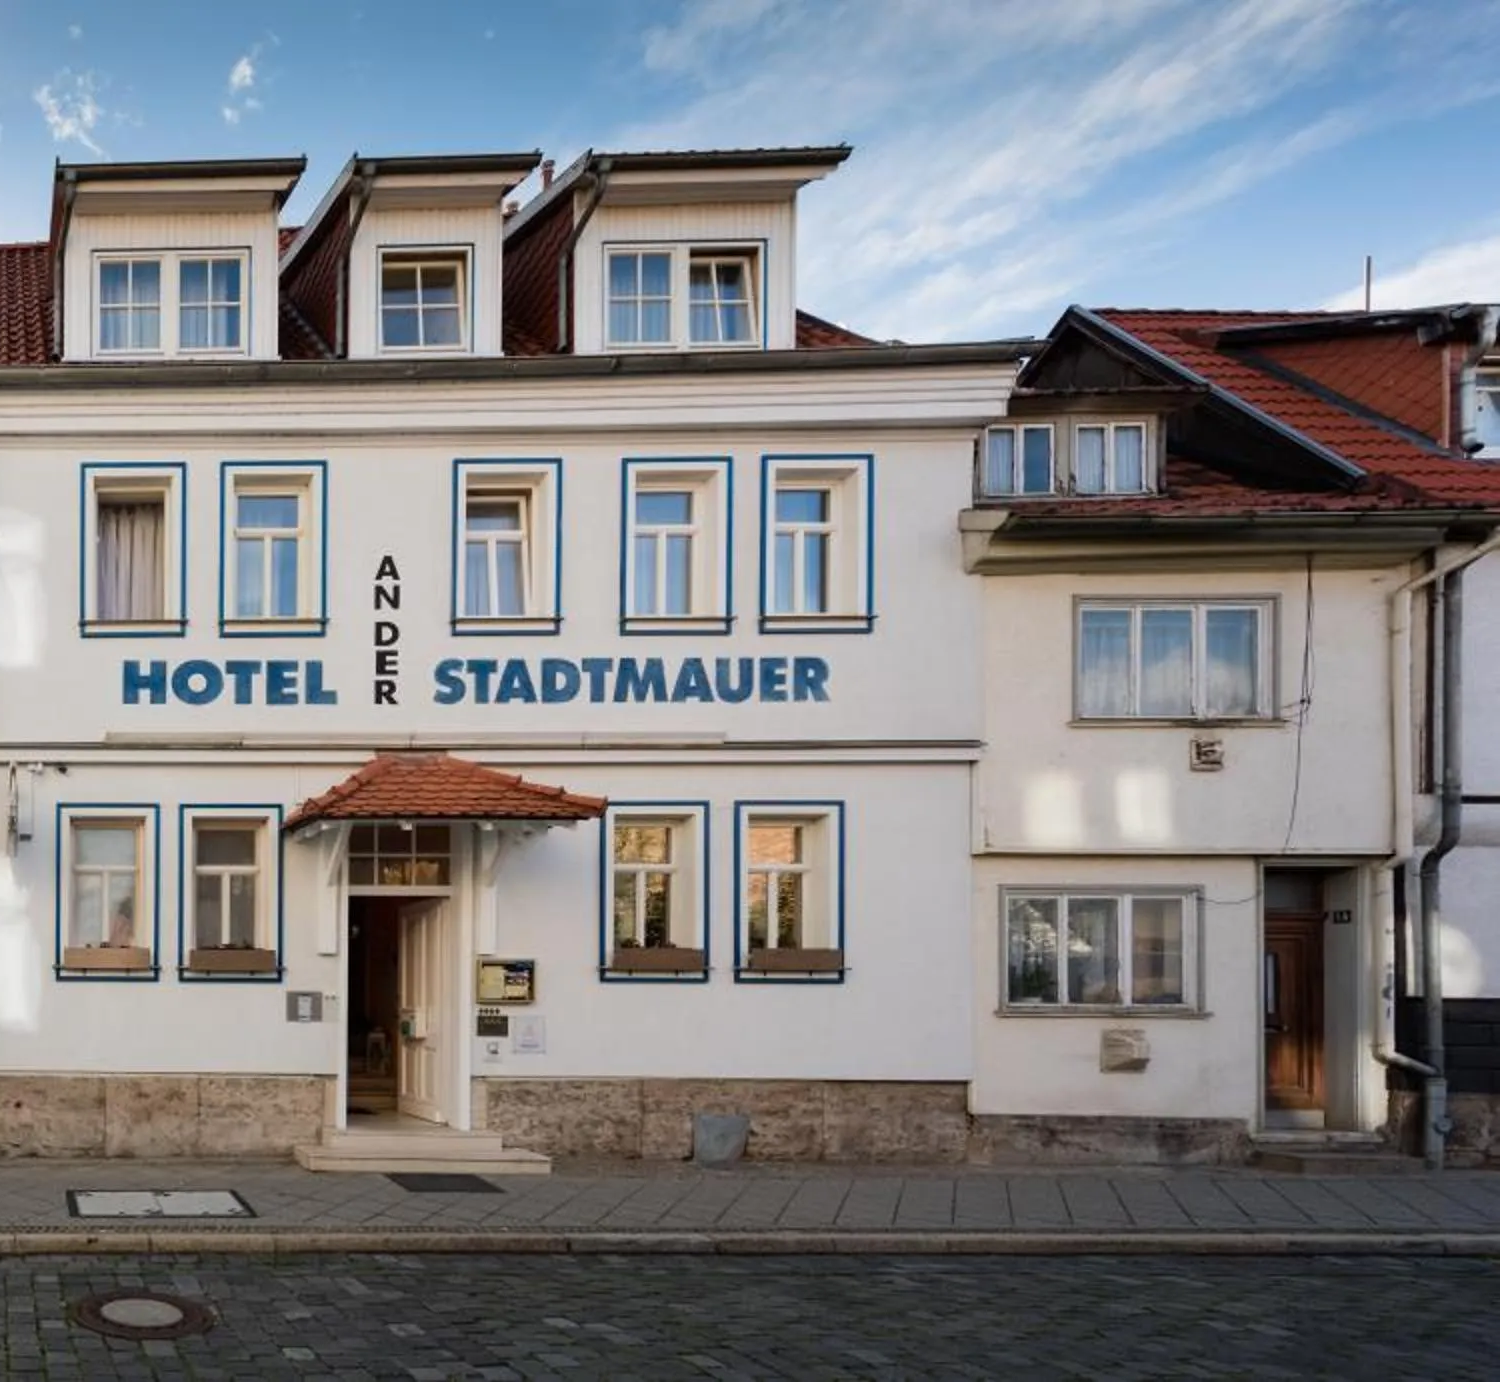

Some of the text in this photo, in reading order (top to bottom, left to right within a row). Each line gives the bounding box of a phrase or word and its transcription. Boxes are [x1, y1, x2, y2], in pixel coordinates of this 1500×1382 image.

[374, 555, 400, 705] AN DER
[122, 659, 338, 705] HOTEL
[433, 657, 832, 704] STADTMAUER
